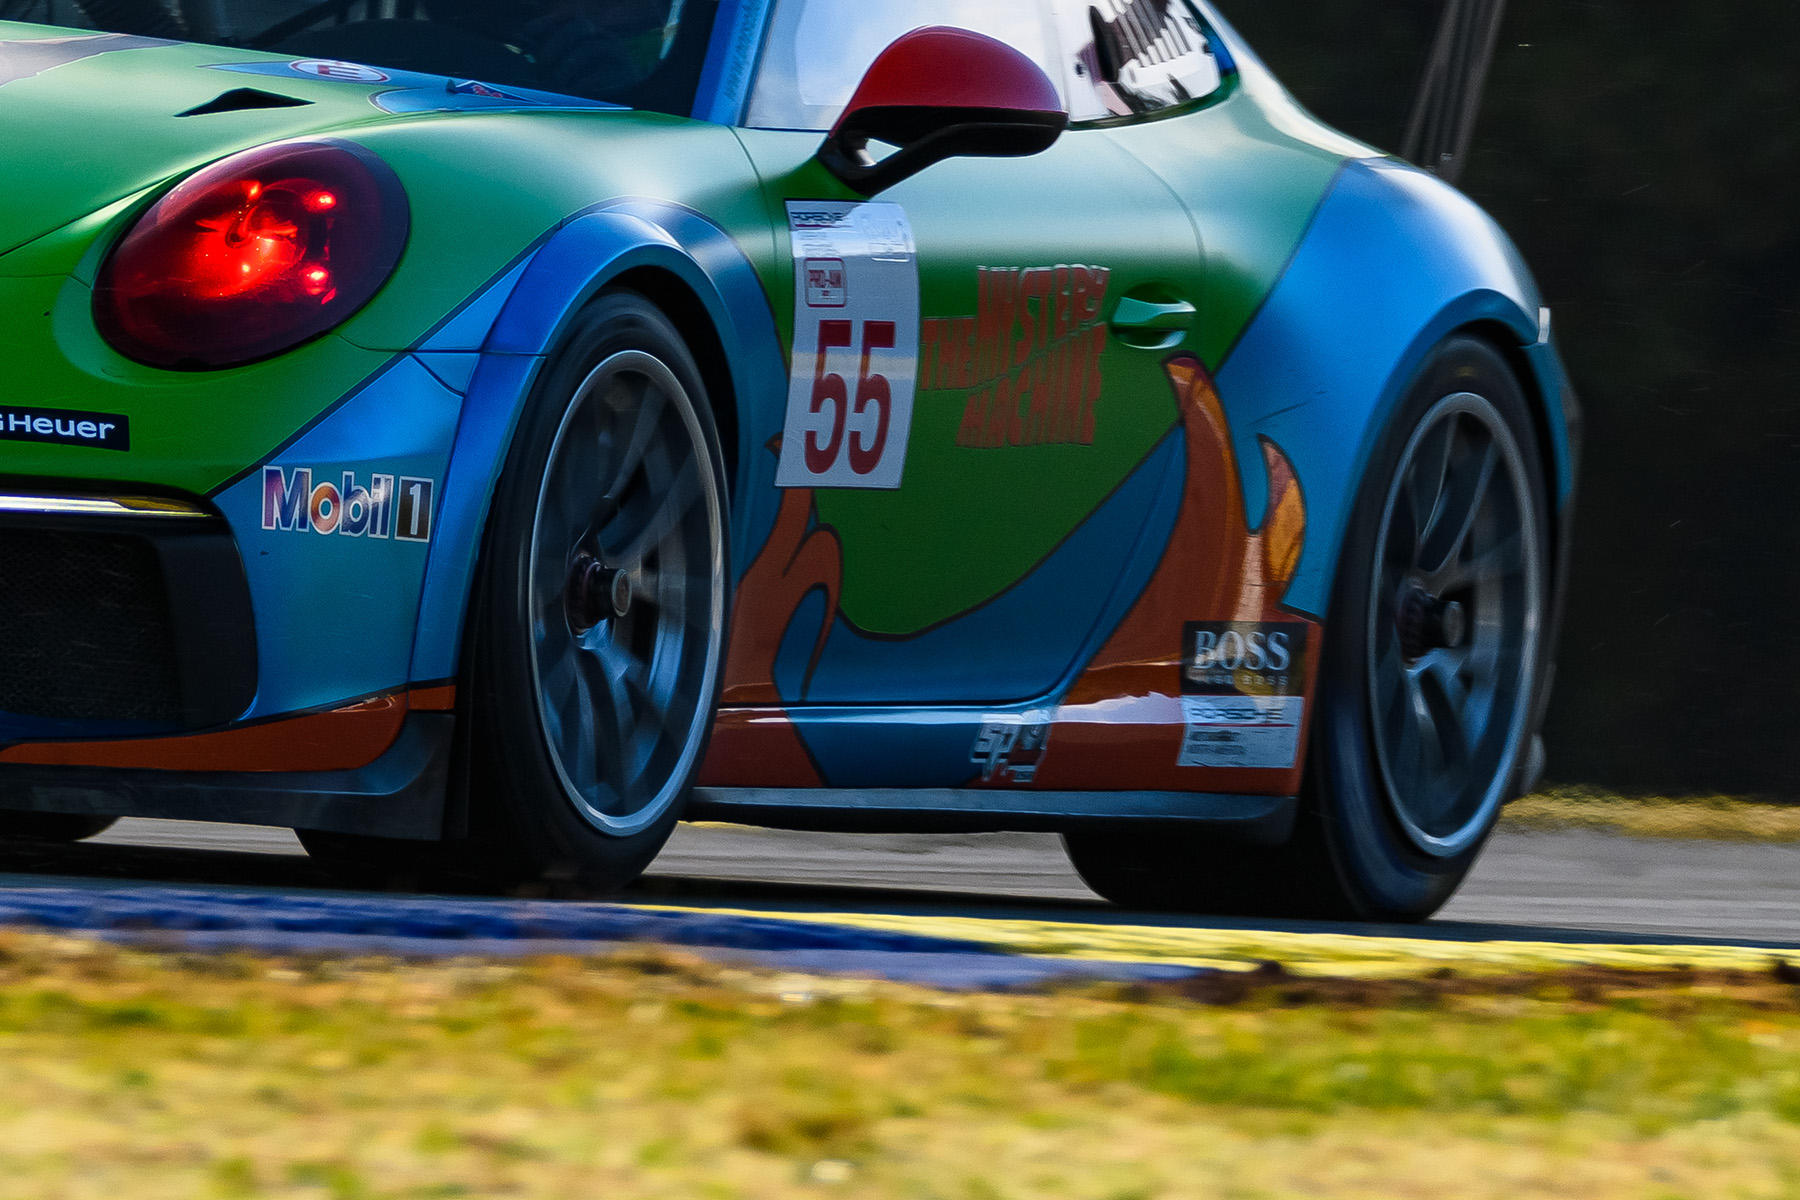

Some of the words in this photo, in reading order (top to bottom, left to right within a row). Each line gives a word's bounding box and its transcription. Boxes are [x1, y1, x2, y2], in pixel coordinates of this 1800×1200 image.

[920, 315, 977, 390] THE
[804, 319, 896, 475] 55
[262, 465, 394, 539] Mobil
[1192, 630, 1290, 671] BOSS
